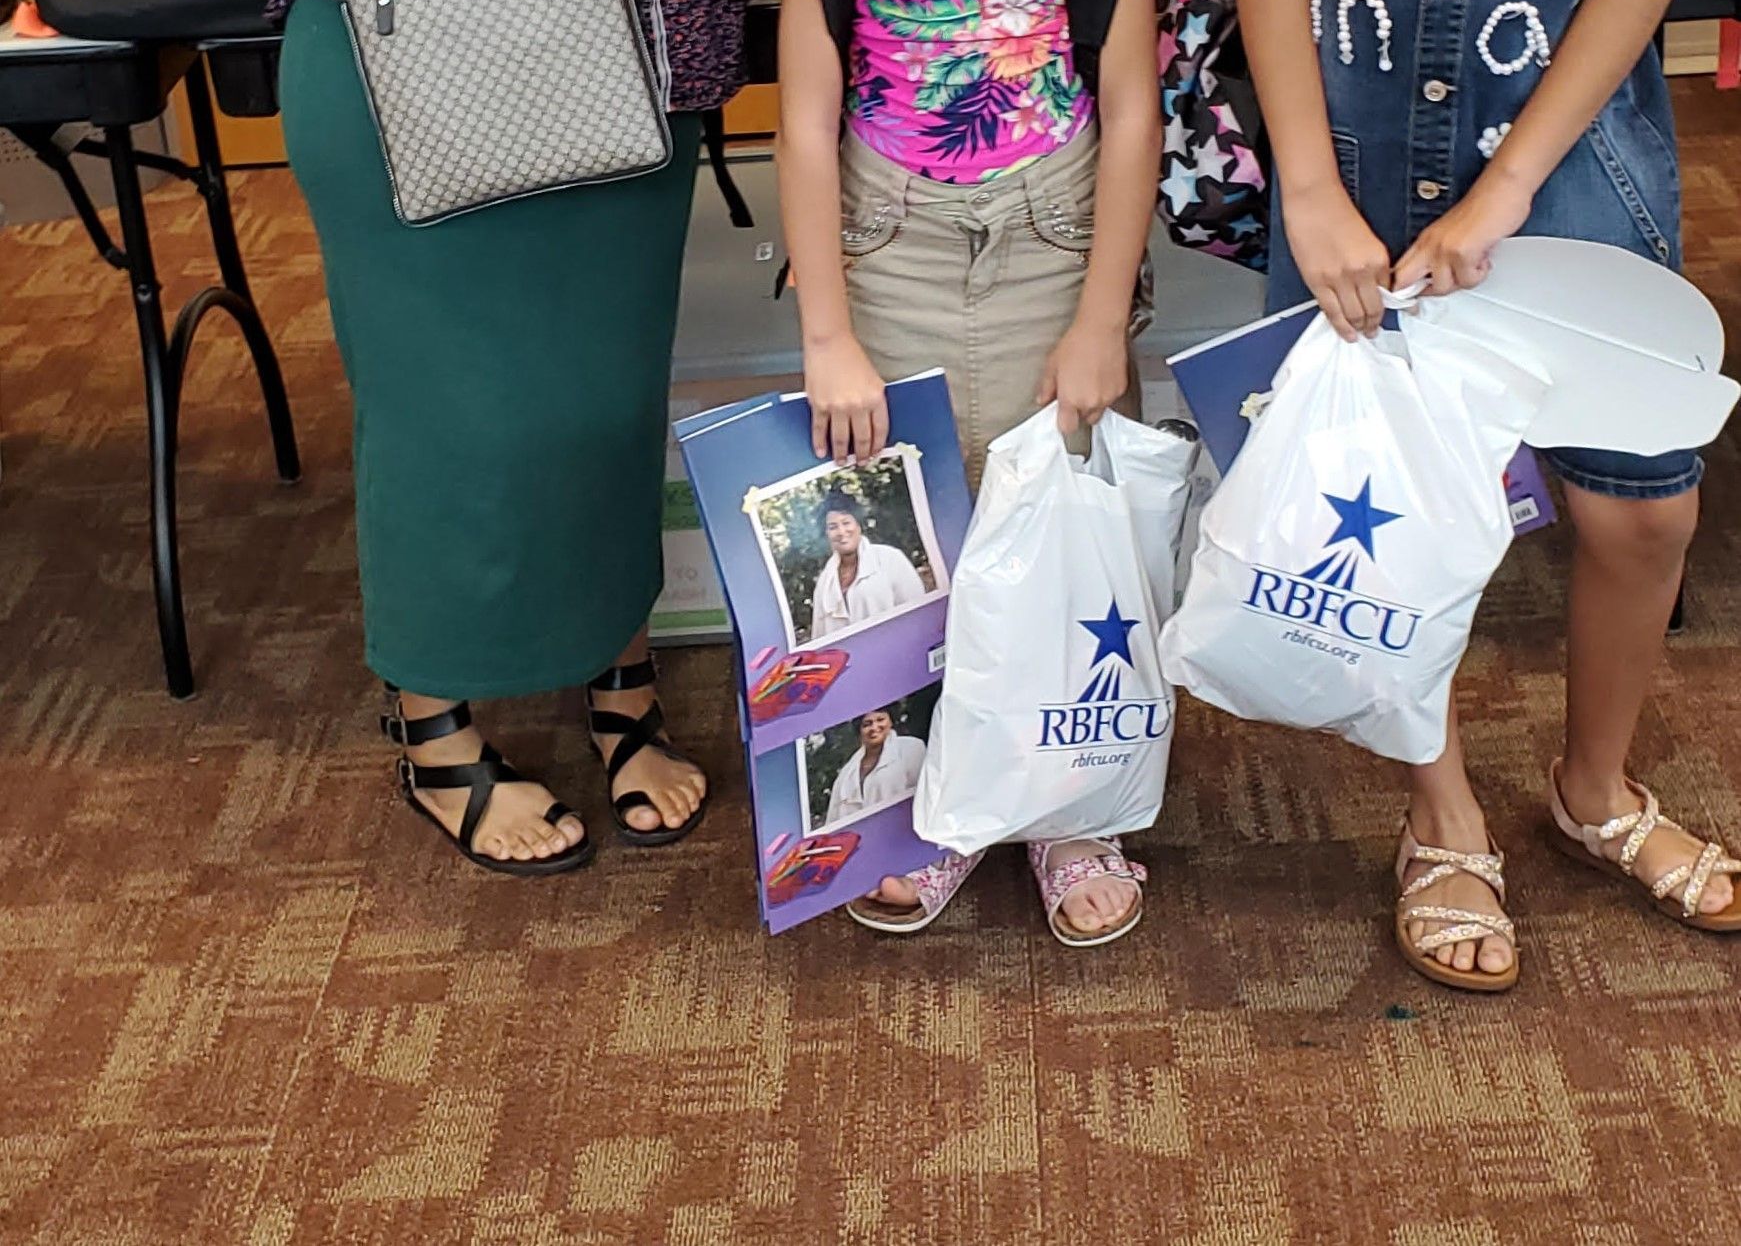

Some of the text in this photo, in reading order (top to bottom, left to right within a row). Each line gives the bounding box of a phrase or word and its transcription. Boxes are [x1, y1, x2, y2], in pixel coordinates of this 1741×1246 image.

[1241, 567, 1422, 650] RBFCU
[1282, 629, 1361, 665] rbfcu.org
[1036, 700, 1171, 746] RBFCU
[1071, 752, 1131, 768] rbfcu.org
